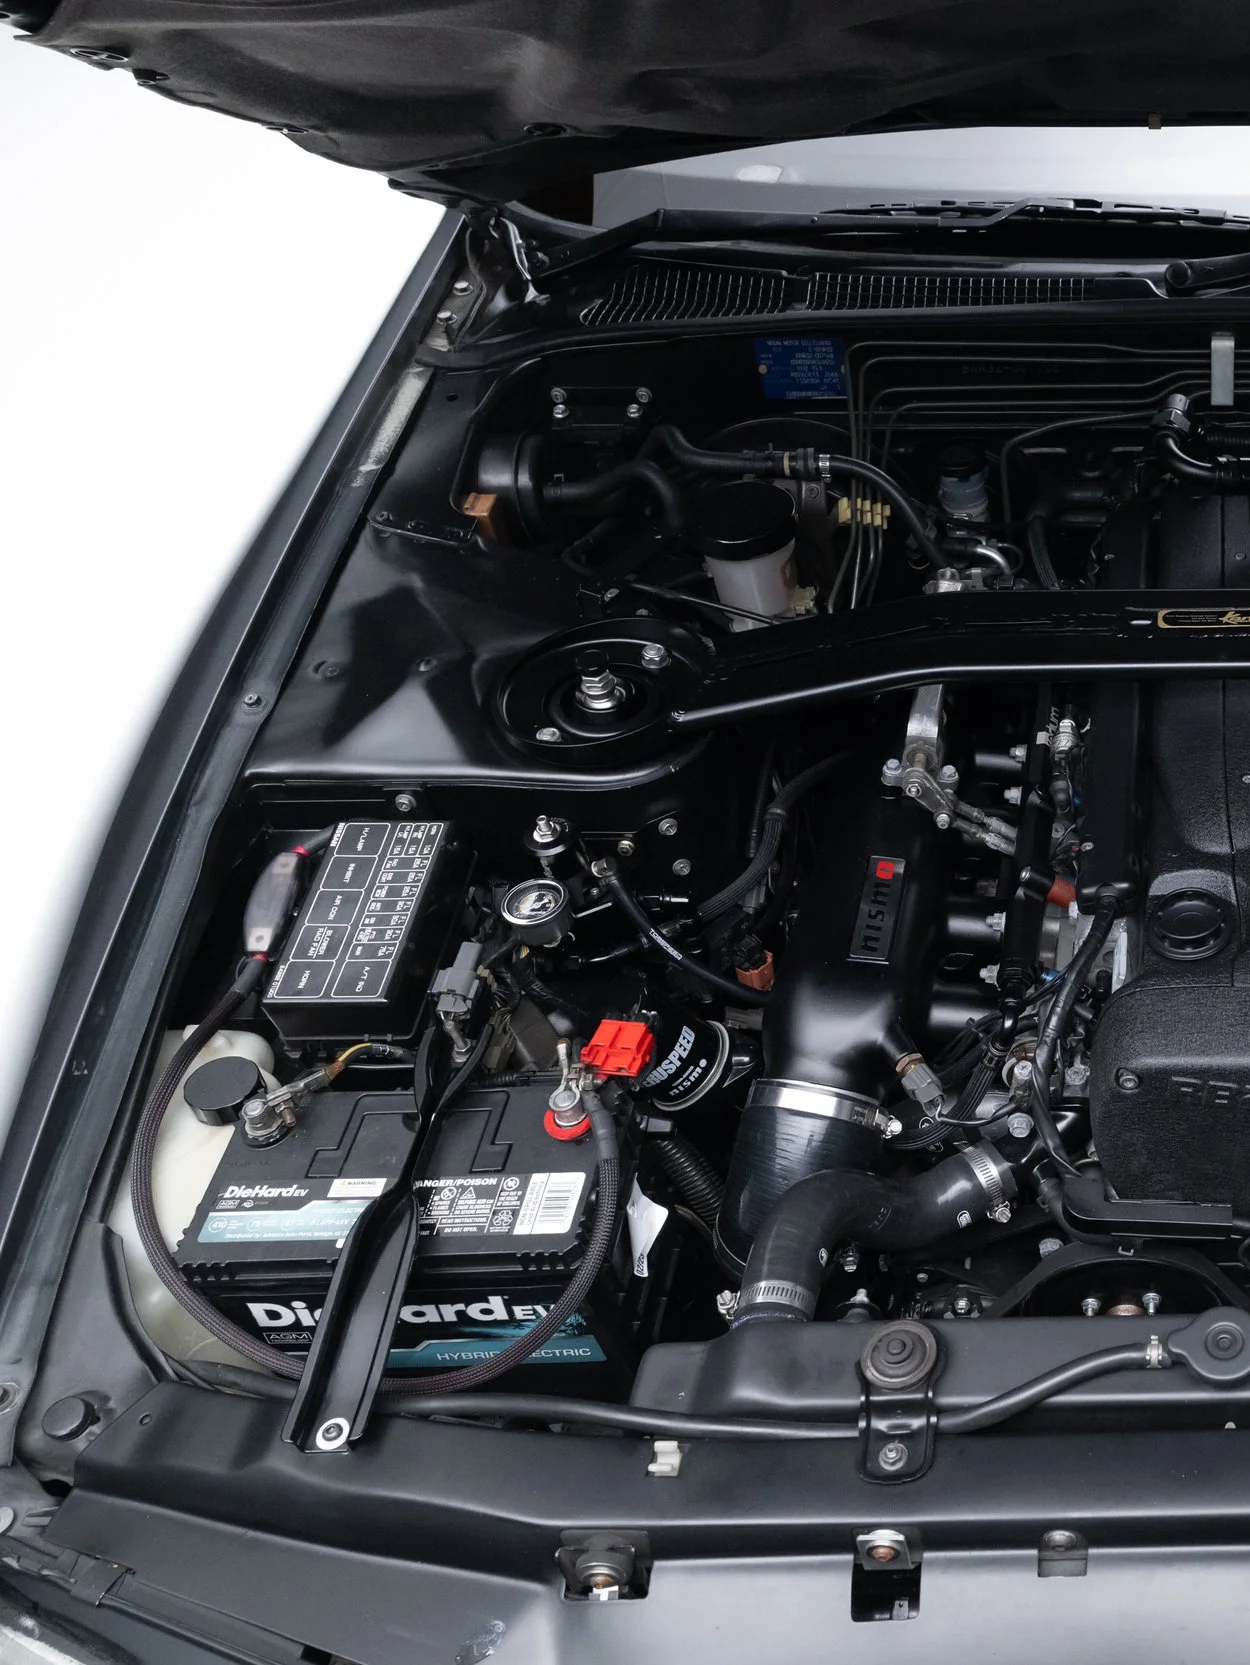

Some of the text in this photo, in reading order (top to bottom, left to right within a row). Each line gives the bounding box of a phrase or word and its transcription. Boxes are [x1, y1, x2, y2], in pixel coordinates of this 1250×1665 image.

[330, 823, 345, 846] NISSAN
[356, 827, 370, 851] H/LAMP
[343, 863, 355, 883] INHIBIT
[327, 895, 342, 920] AIR CON
[861, 861, 895, 953] nismo
[307, 928, 324, 956] RAD FAN
[318, 930, 333, 955] BLOWER
[297, 970, 311, 989] HORN
[360, 966, 370, 979] A/T
[221, 1184, 310, 1198] DieHard EV
[246, 1296, 509, 1327] Diard
[529, 1347, 592, 1358] ECTRIC
